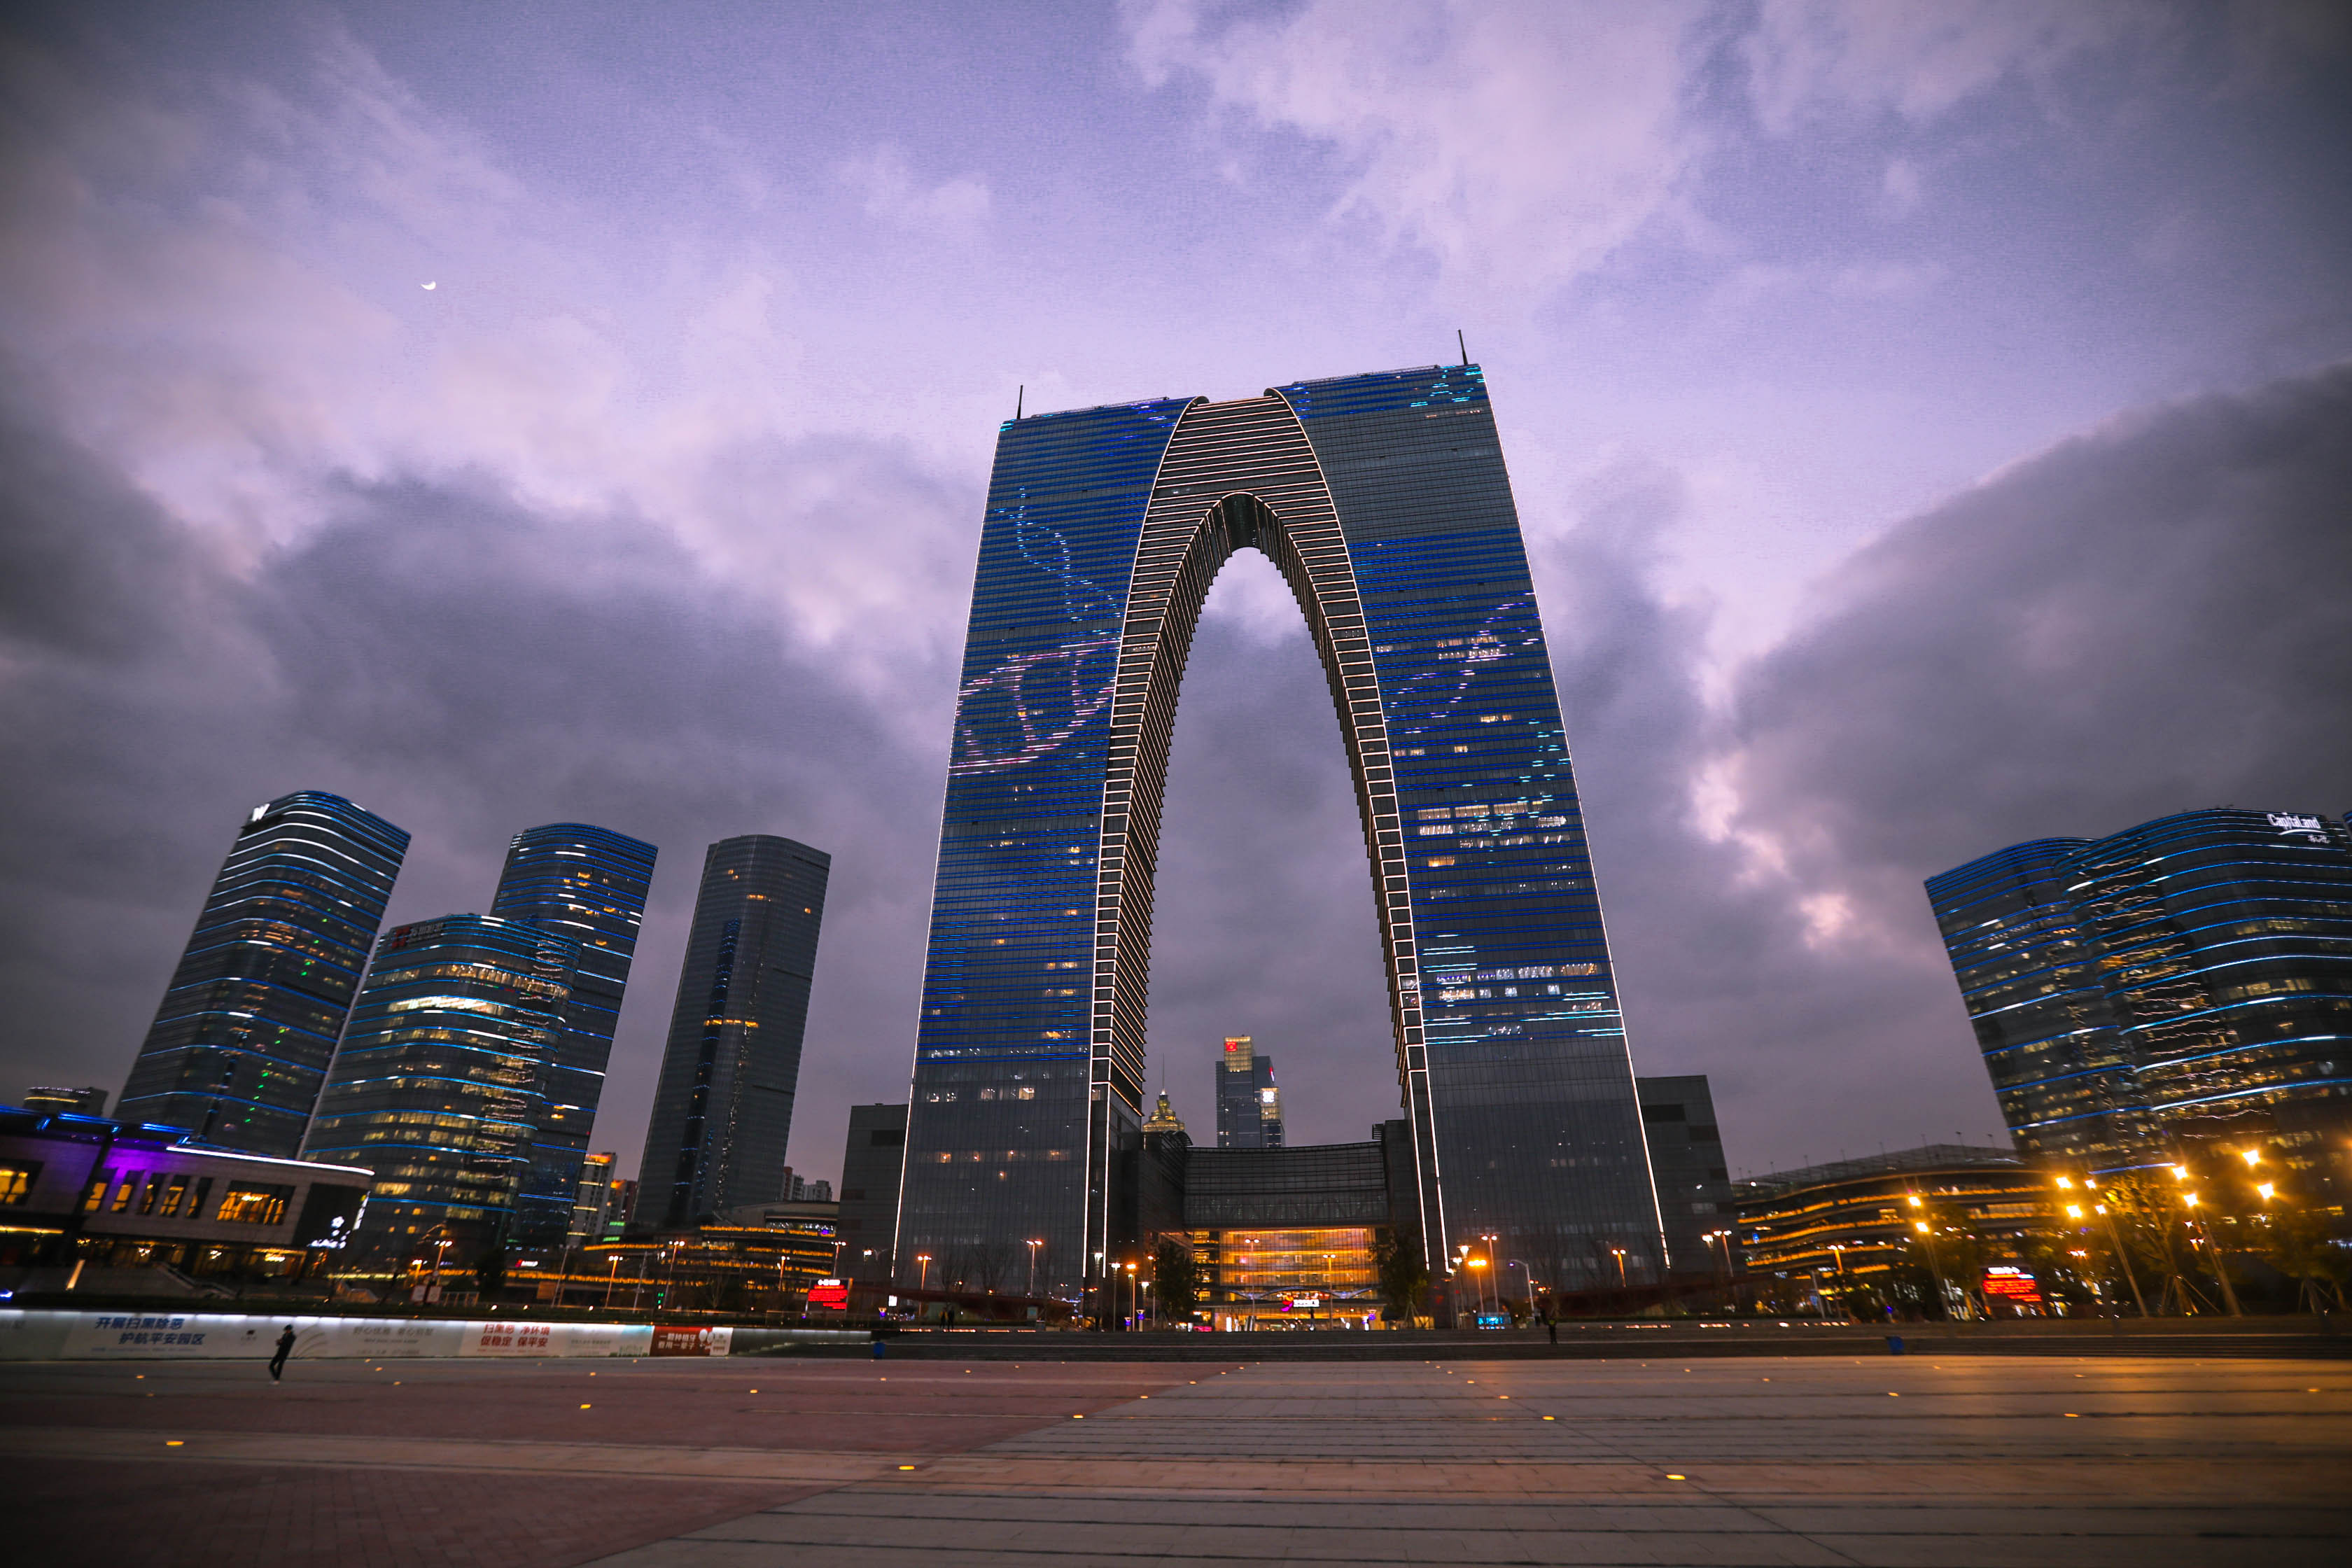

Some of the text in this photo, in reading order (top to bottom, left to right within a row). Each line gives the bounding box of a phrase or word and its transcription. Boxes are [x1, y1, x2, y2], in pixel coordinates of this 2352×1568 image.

[2267, 812, 2321, 830] CapitaLand
[94, 1317, 186, 1329] 开展扫黑除恶
[118, 1332, 206, 1345] 护航平安园区
[480, 1335, 549, 1348] 促稳定 保平安
